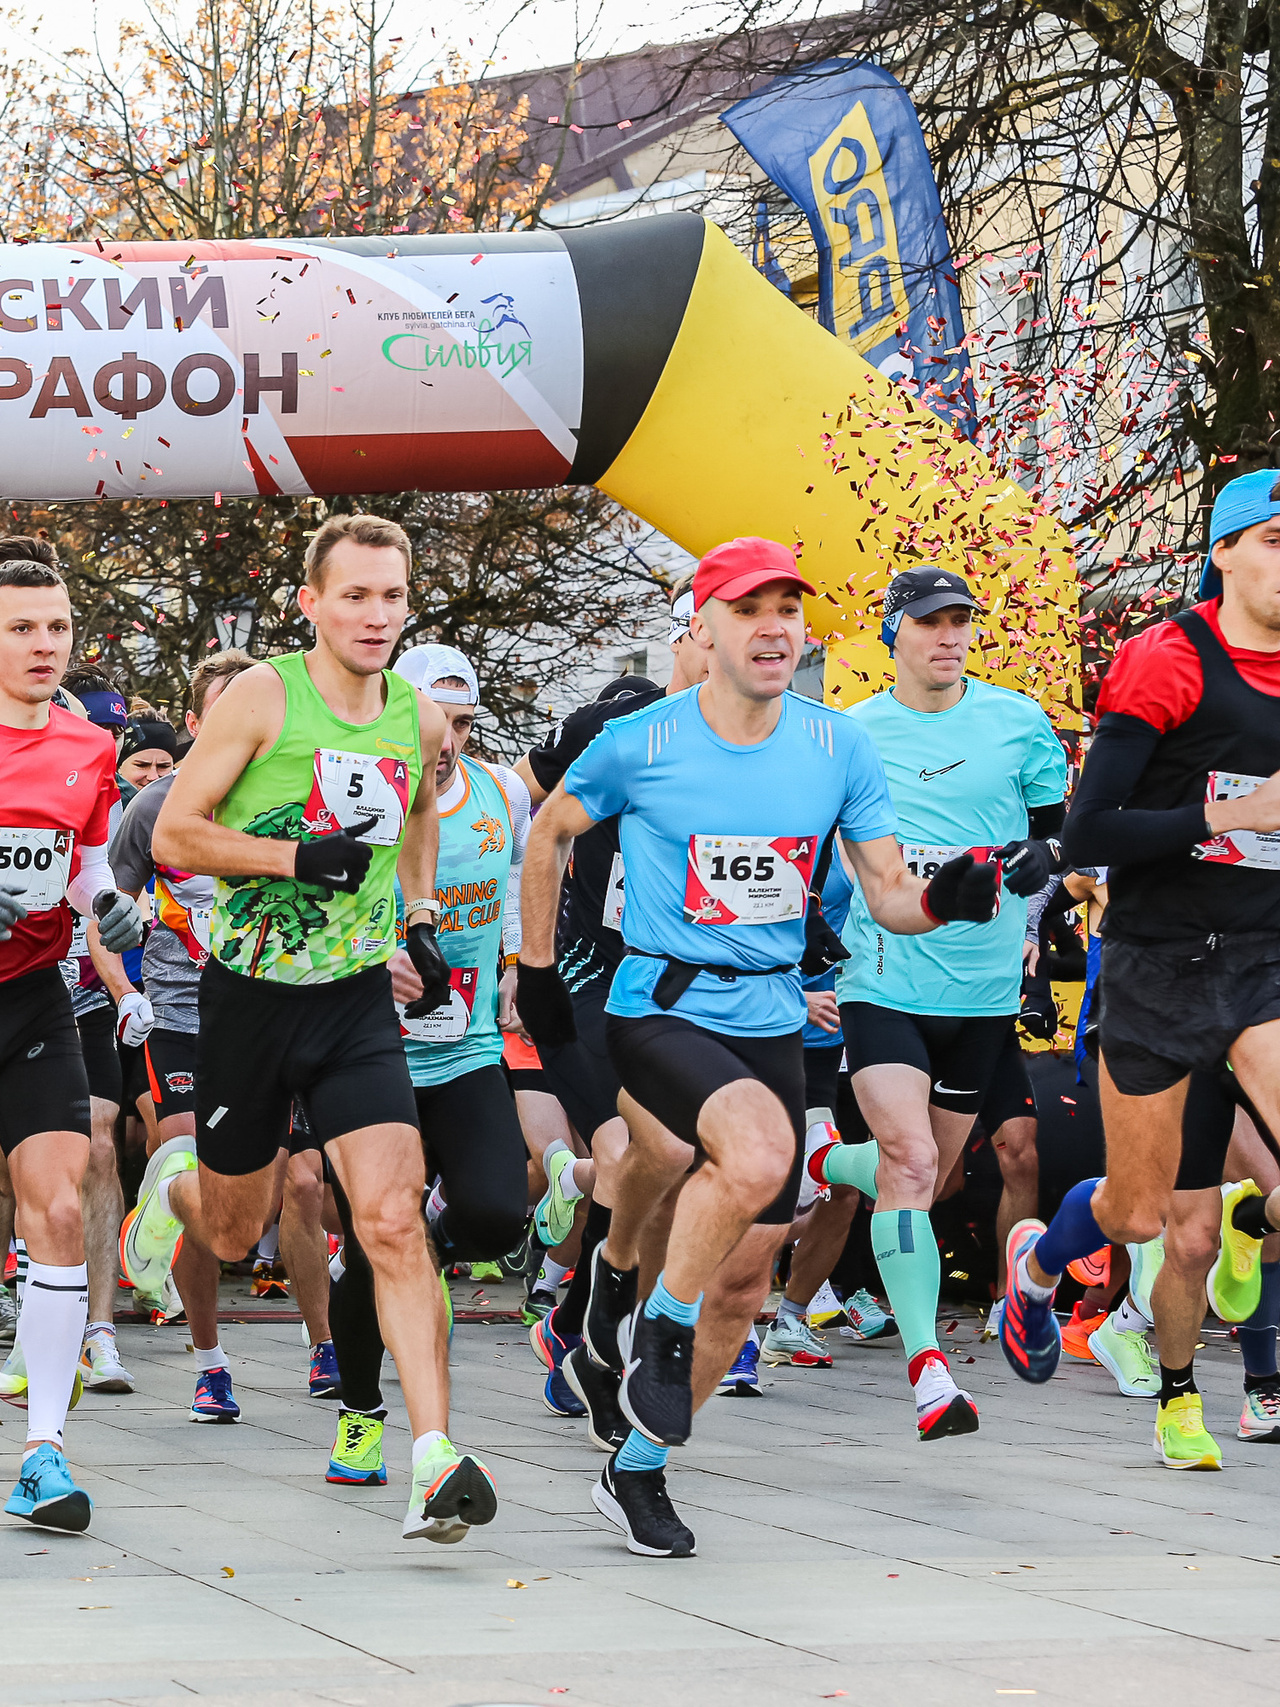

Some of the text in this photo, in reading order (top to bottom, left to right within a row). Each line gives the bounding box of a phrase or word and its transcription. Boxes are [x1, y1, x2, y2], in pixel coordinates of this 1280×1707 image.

[377, 310, 475, 321] КЛУБ ЛЮБИТЕЛЕЙ БЕГА
[405, 321, 476, 330] sylvia.gatchina.ru
[382, 319, 532, 379] Сильвия
[394, 765, 406, 780] A
[346, 772, 364, 798] 5
[55, 835, 66, 849] A
[798, 841, 810, 854] A
[987, 851, 998, 863] A
[710, 855, 775, 882] 165
[433, 878, 498, 909] NNING
[467, 899, 501, 928] CLUB
[876, 933, 885, 976] NIKE PRO
[462, 972, 472, 985] B
[877, 1249, 897, 1261] cep
